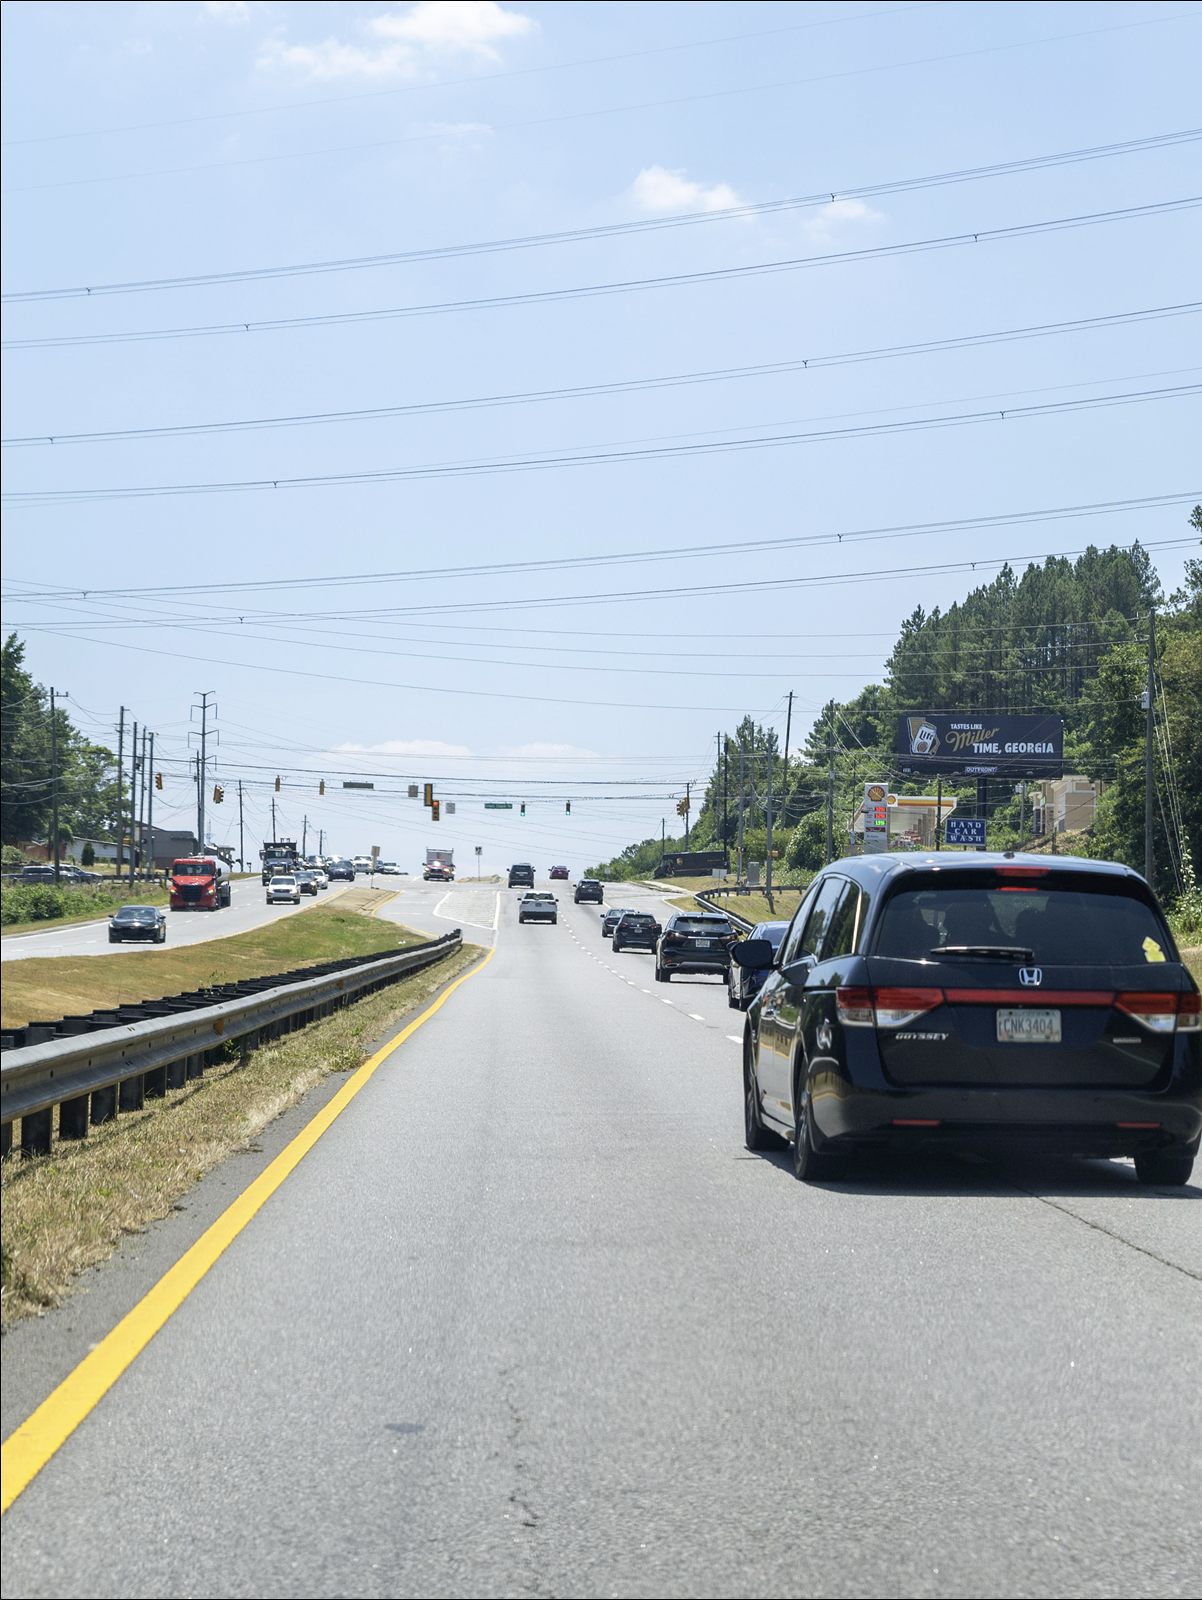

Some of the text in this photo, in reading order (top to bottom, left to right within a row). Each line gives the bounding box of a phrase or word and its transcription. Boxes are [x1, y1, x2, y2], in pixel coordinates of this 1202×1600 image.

[945, 727, 1000, 753] Miller
[972, 742, 1054, 755] TIME, GEORGIA
[950, 821, 982, 829] HAND
[950, 834, 982, 842] WASH
[1003, 1018, 1054, 1035] CNK3404
[895, 1032, 949, 1040] ODYSSEY
